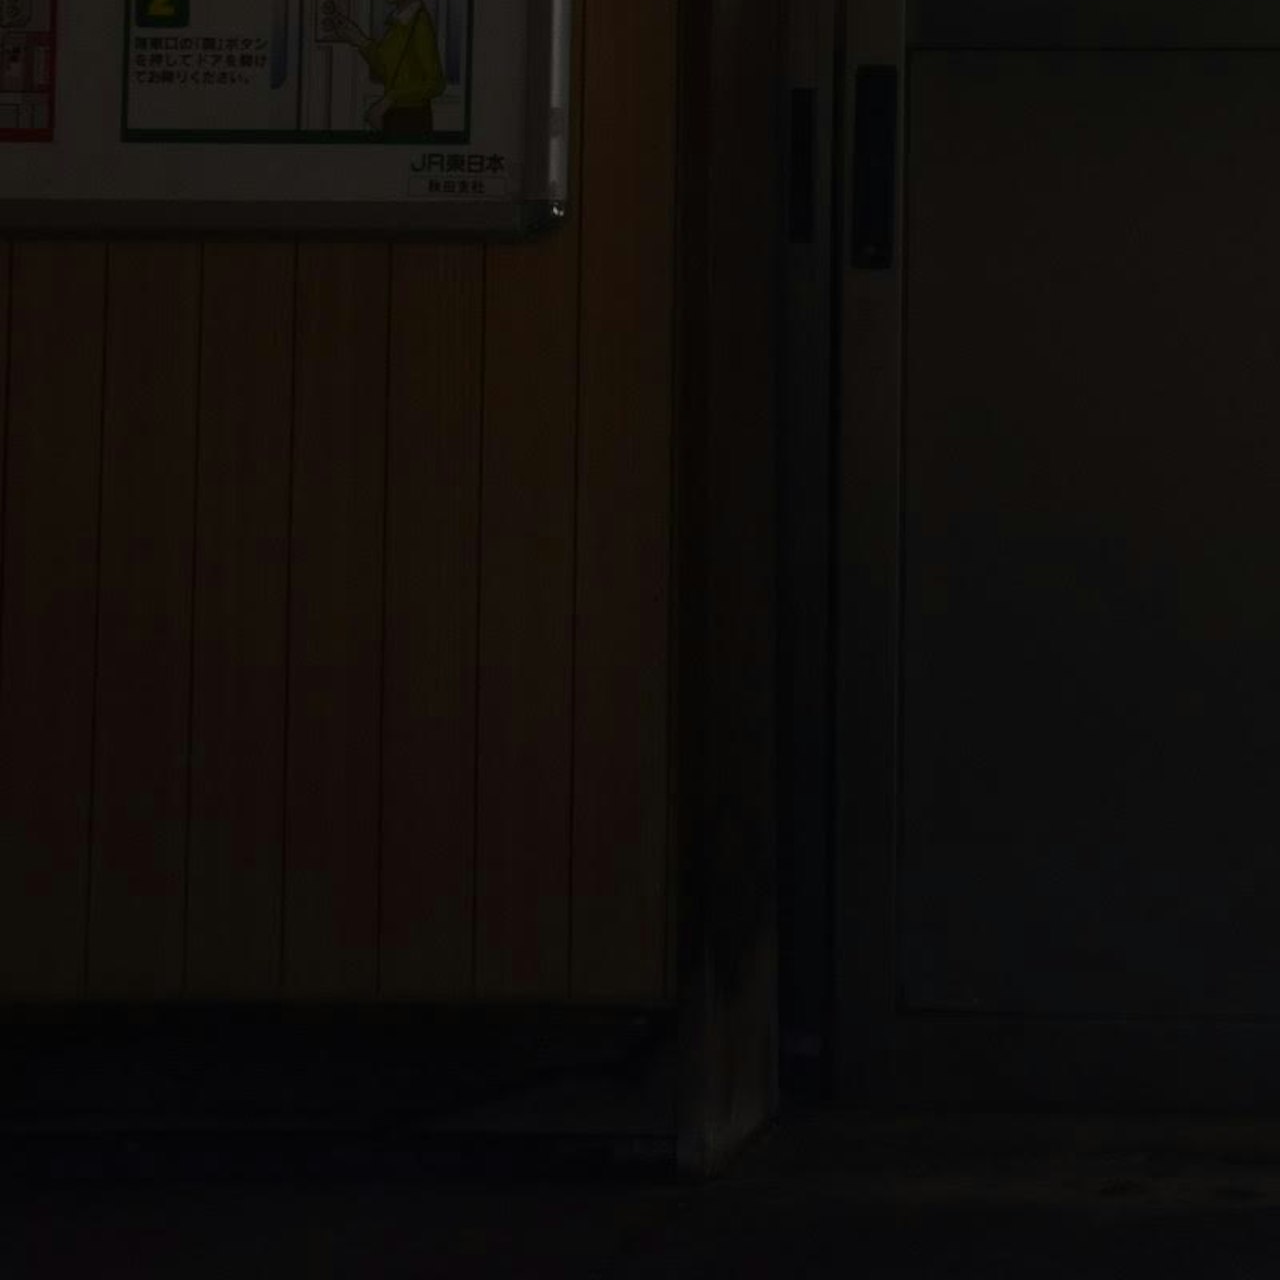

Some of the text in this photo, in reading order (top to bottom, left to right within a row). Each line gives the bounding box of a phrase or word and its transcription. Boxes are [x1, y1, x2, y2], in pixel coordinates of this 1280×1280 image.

[410, 153, 505, 174] JR東日本
[428, 179, 486, 194] 秋田支社
